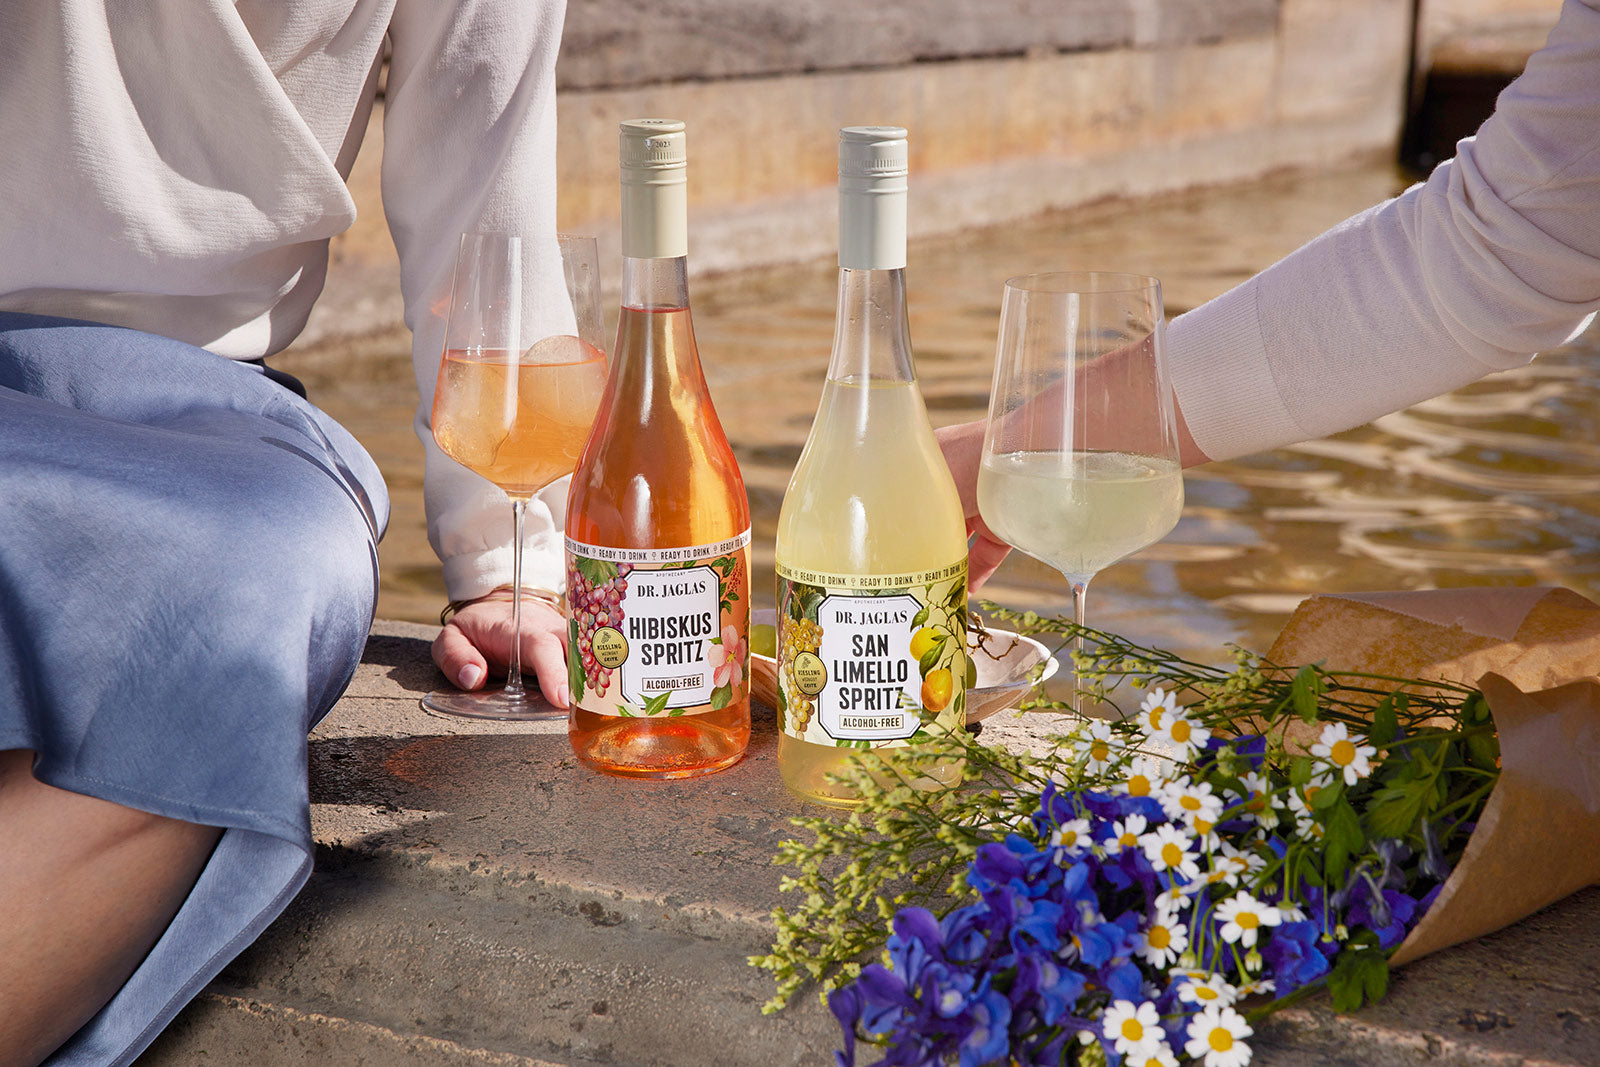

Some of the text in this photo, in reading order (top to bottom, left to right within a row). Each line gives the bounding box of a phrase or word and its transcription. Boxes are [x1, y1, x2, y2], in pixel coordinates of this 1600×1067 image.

[599, 549, 616, 559] READY
[619, 552, 626, 560] TO
[629, 552, 647, 560] DRINK
[661, 551, 681, 560] READY
[684, 550, 691, 558] TO
[693, 547, 710, 558] DRINK
[720, 540, 734, 552] READY
[801, 572, 817, 583] READY
[819, 575, 826, 584] TO
[828, 576, 846, 586] DRINK
[860, 578, 881, 587] READY
[884, 577, 892, 586] TO
[895, 575, 914, 586] DRINK
[925, 570, 941, 582] READY
[943, 568, 949, 577] TO
[637, 581, 706, 598] DR. JAGLAS
[629, 612, 712, 640] HIBISKUS
[835, 610, 908, 625] DR. JAGLAS
[641, 640, 704, 666] SPRITZ
[852, 634, 889, 658] SAN
[833, 659, 908, 684] LIMELLO
[646, 676, 701, 690] ALCOHOL-FREE
[839, 686, 904, 710] SPRITZ
[843, 717, 900, 728] ALCOHOL-FREE
